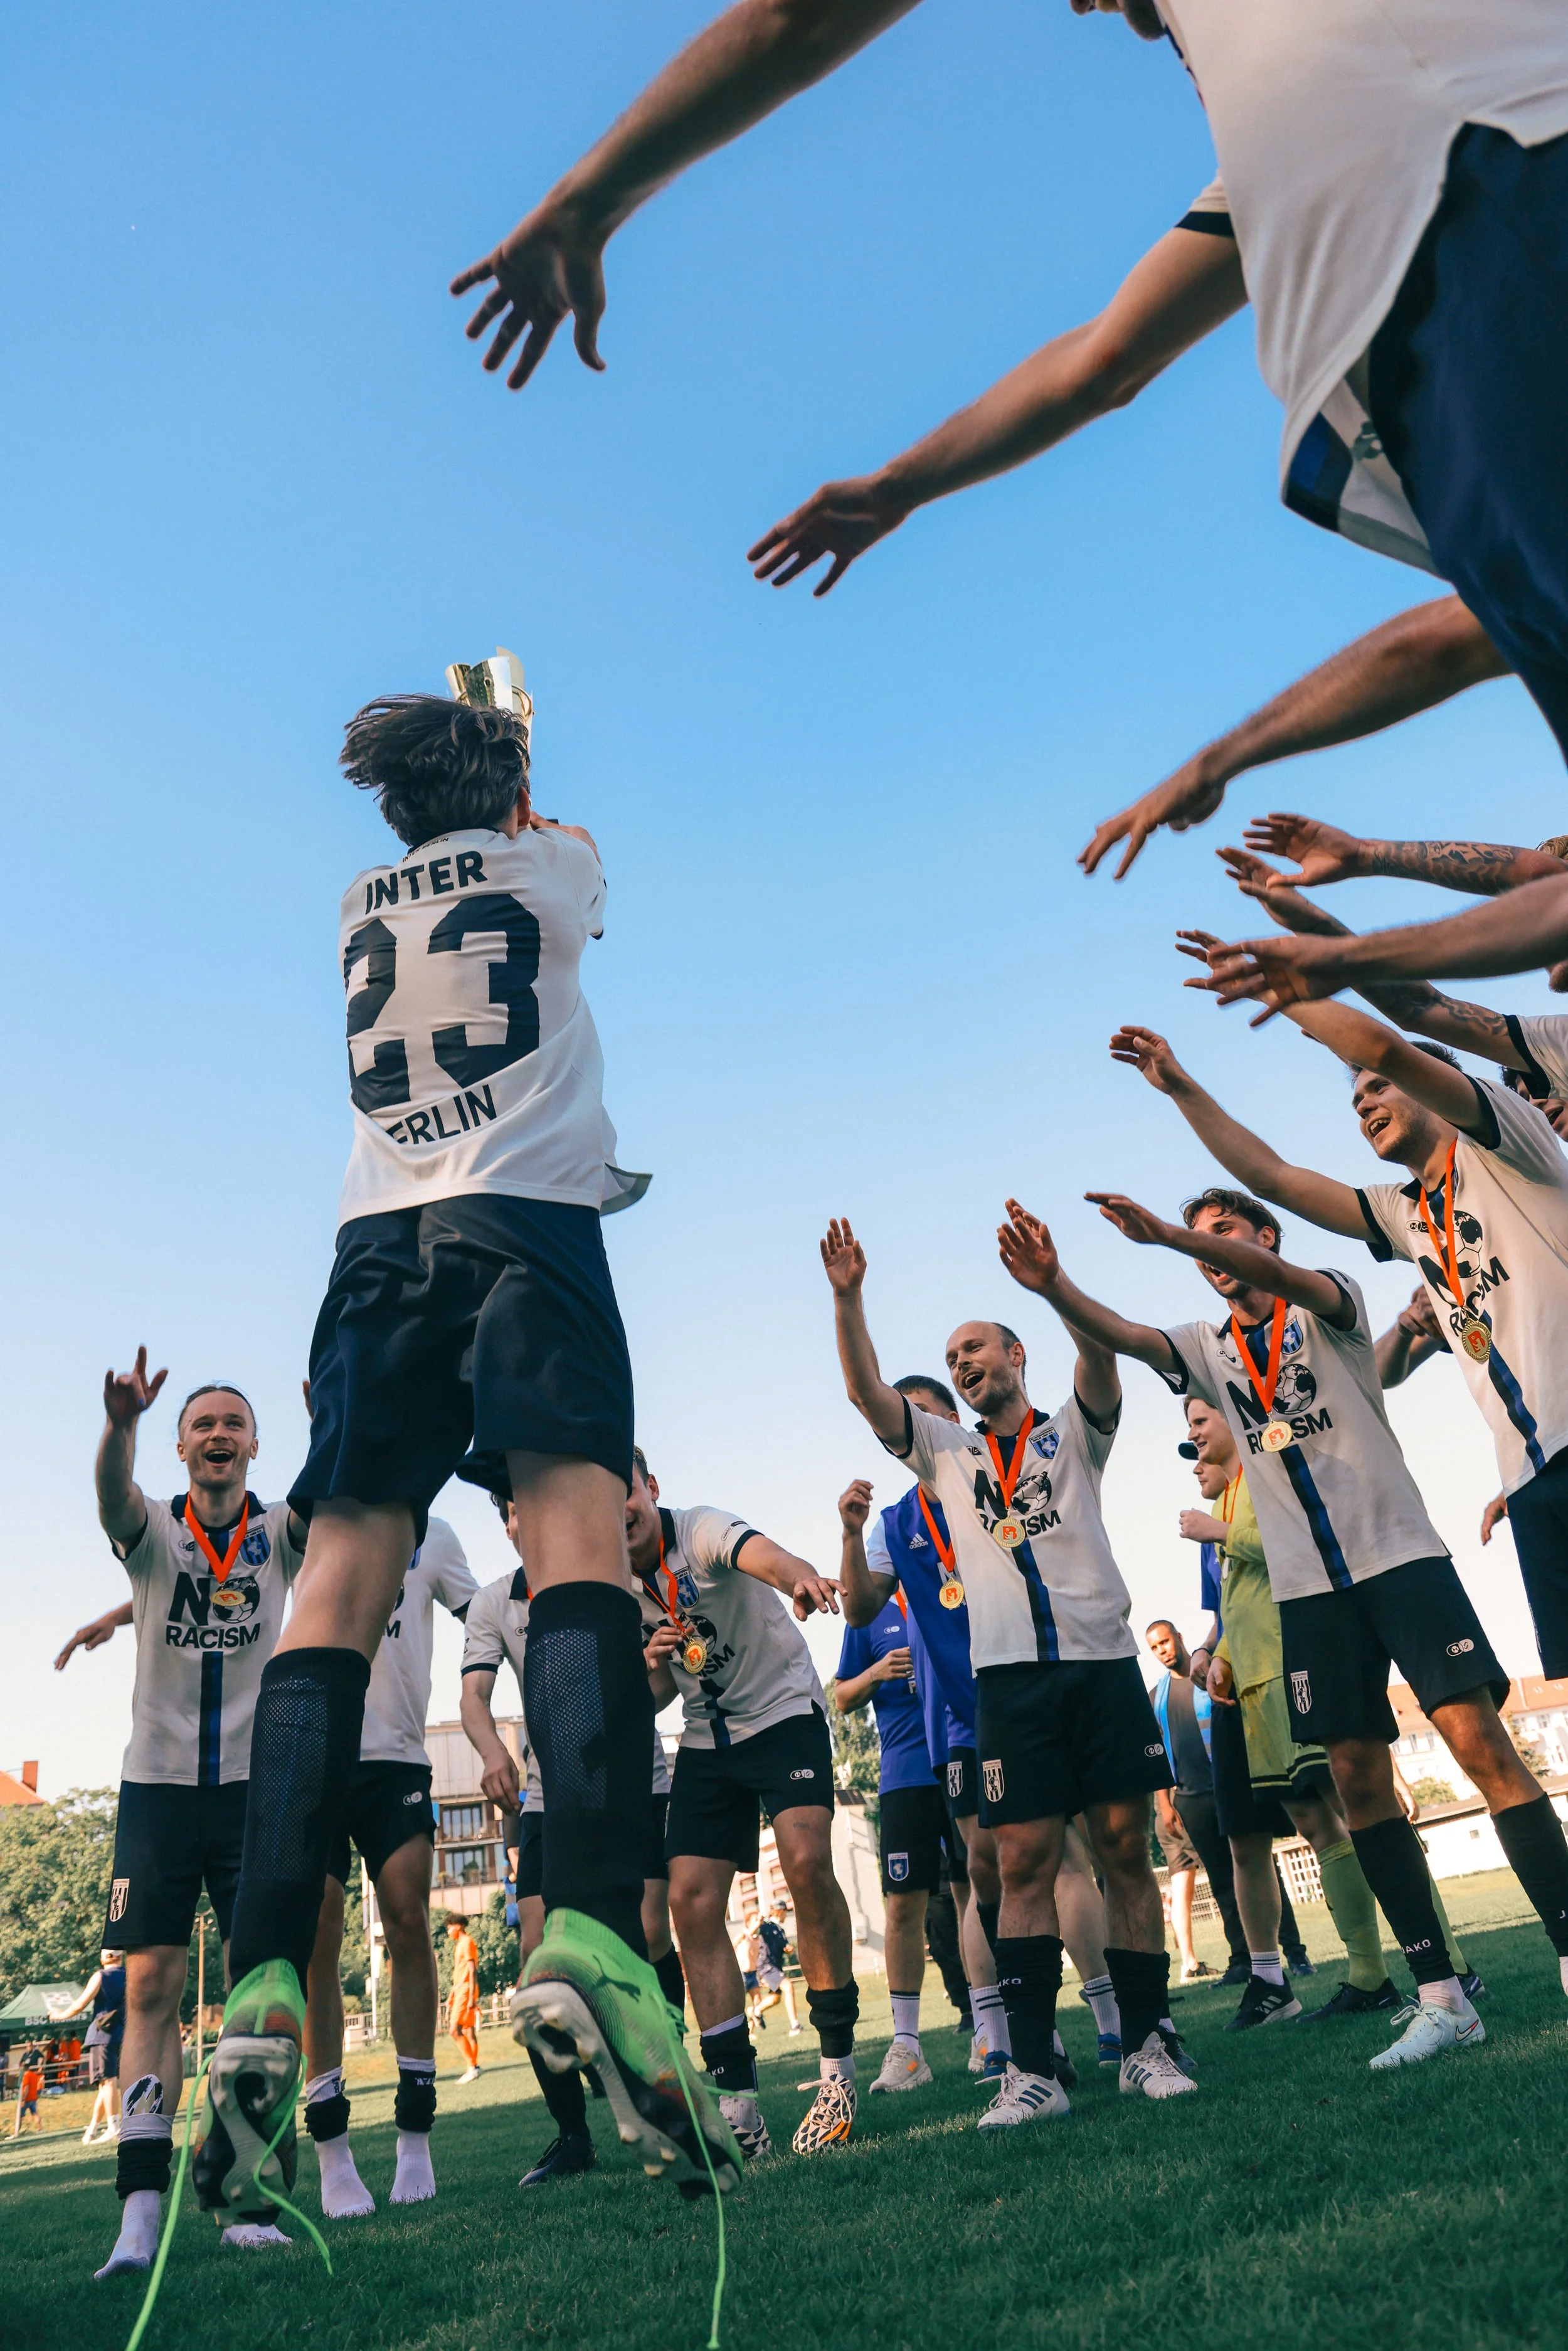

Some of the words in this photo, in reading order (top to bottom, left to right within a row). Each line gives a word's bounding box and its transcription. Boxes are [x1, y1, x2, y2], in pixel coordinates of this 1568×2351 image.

[365, 851, 487, 915] INTER
[343, 893, 541, 1113] 23
[386, 1084, 497, 1144] ERLIN
[1246, 1407, 1333, 1455] RSM
[909, 1541, 929, 1550] adidas
[166, 1622, 261, 1649] RACISM
[25, 2015, 48, 2026] BSC
